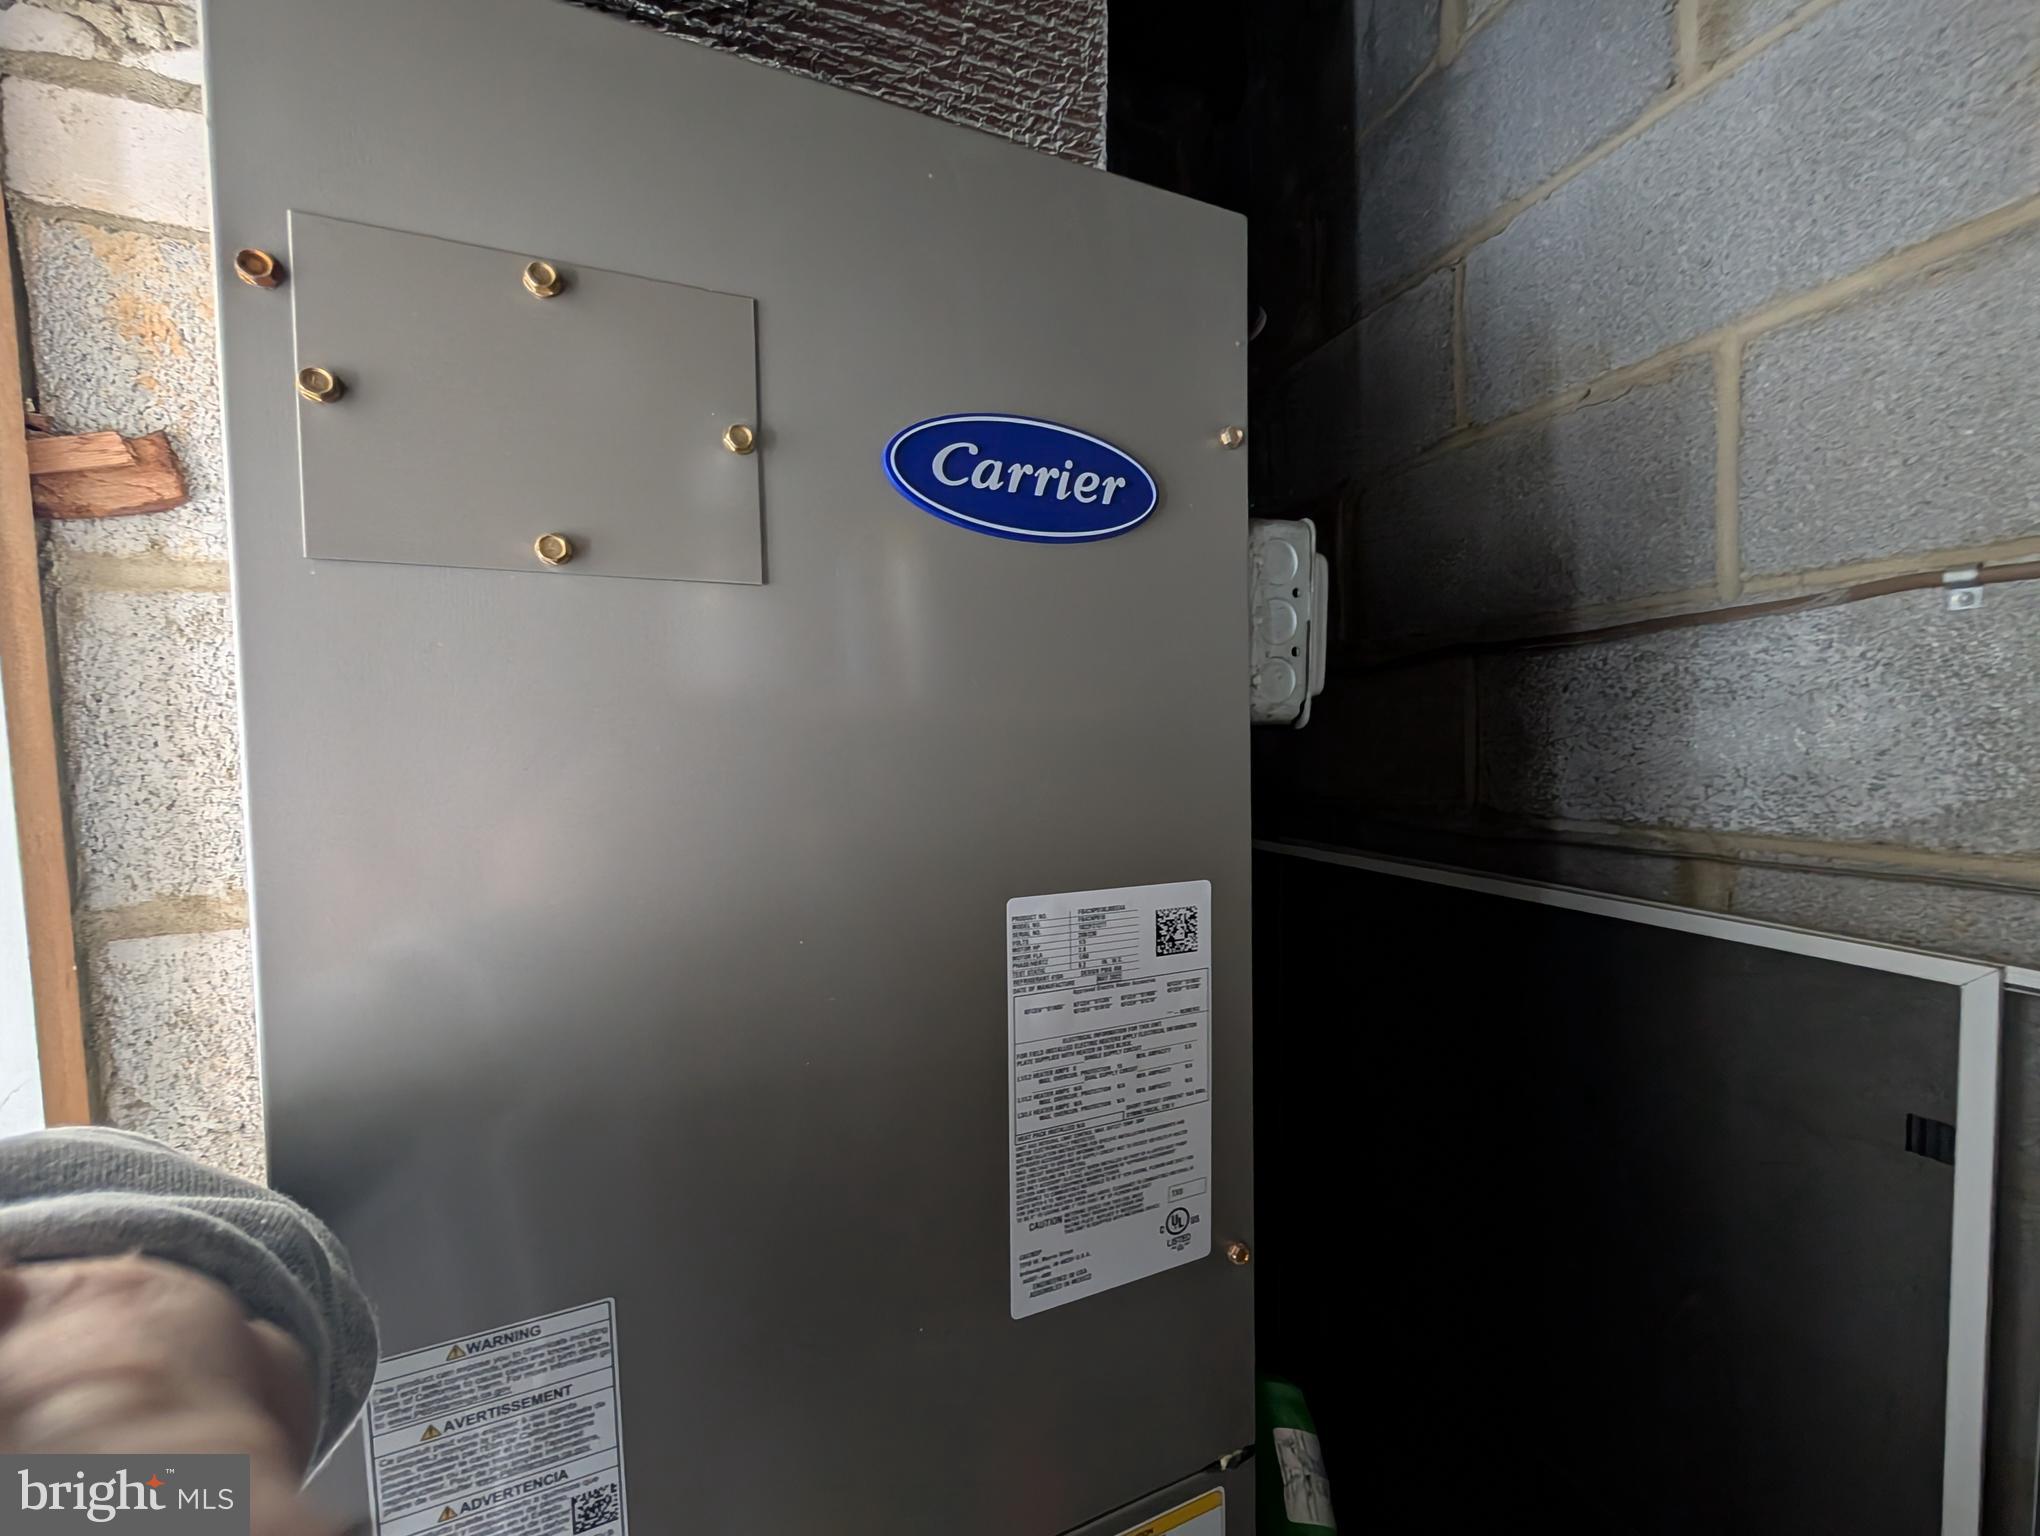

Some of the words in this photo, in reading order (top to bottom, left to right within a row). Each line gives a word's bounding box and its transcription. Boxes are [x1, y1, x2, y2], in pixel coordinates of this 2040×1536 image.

[931, 441, 1126, 505] Carrier
[1029, 1216, 1062, 1232] CAUTION
[1171, 1214, 1184, 1228] UL
[1167, 1233, 1191, 1247] LISTED
[466, 1323, 541, 1355] WARNING
[443, 1383, 573, 1433] AVERTISSEMENT
[459, 1468, 568, 1513] ADVERTENCIA
